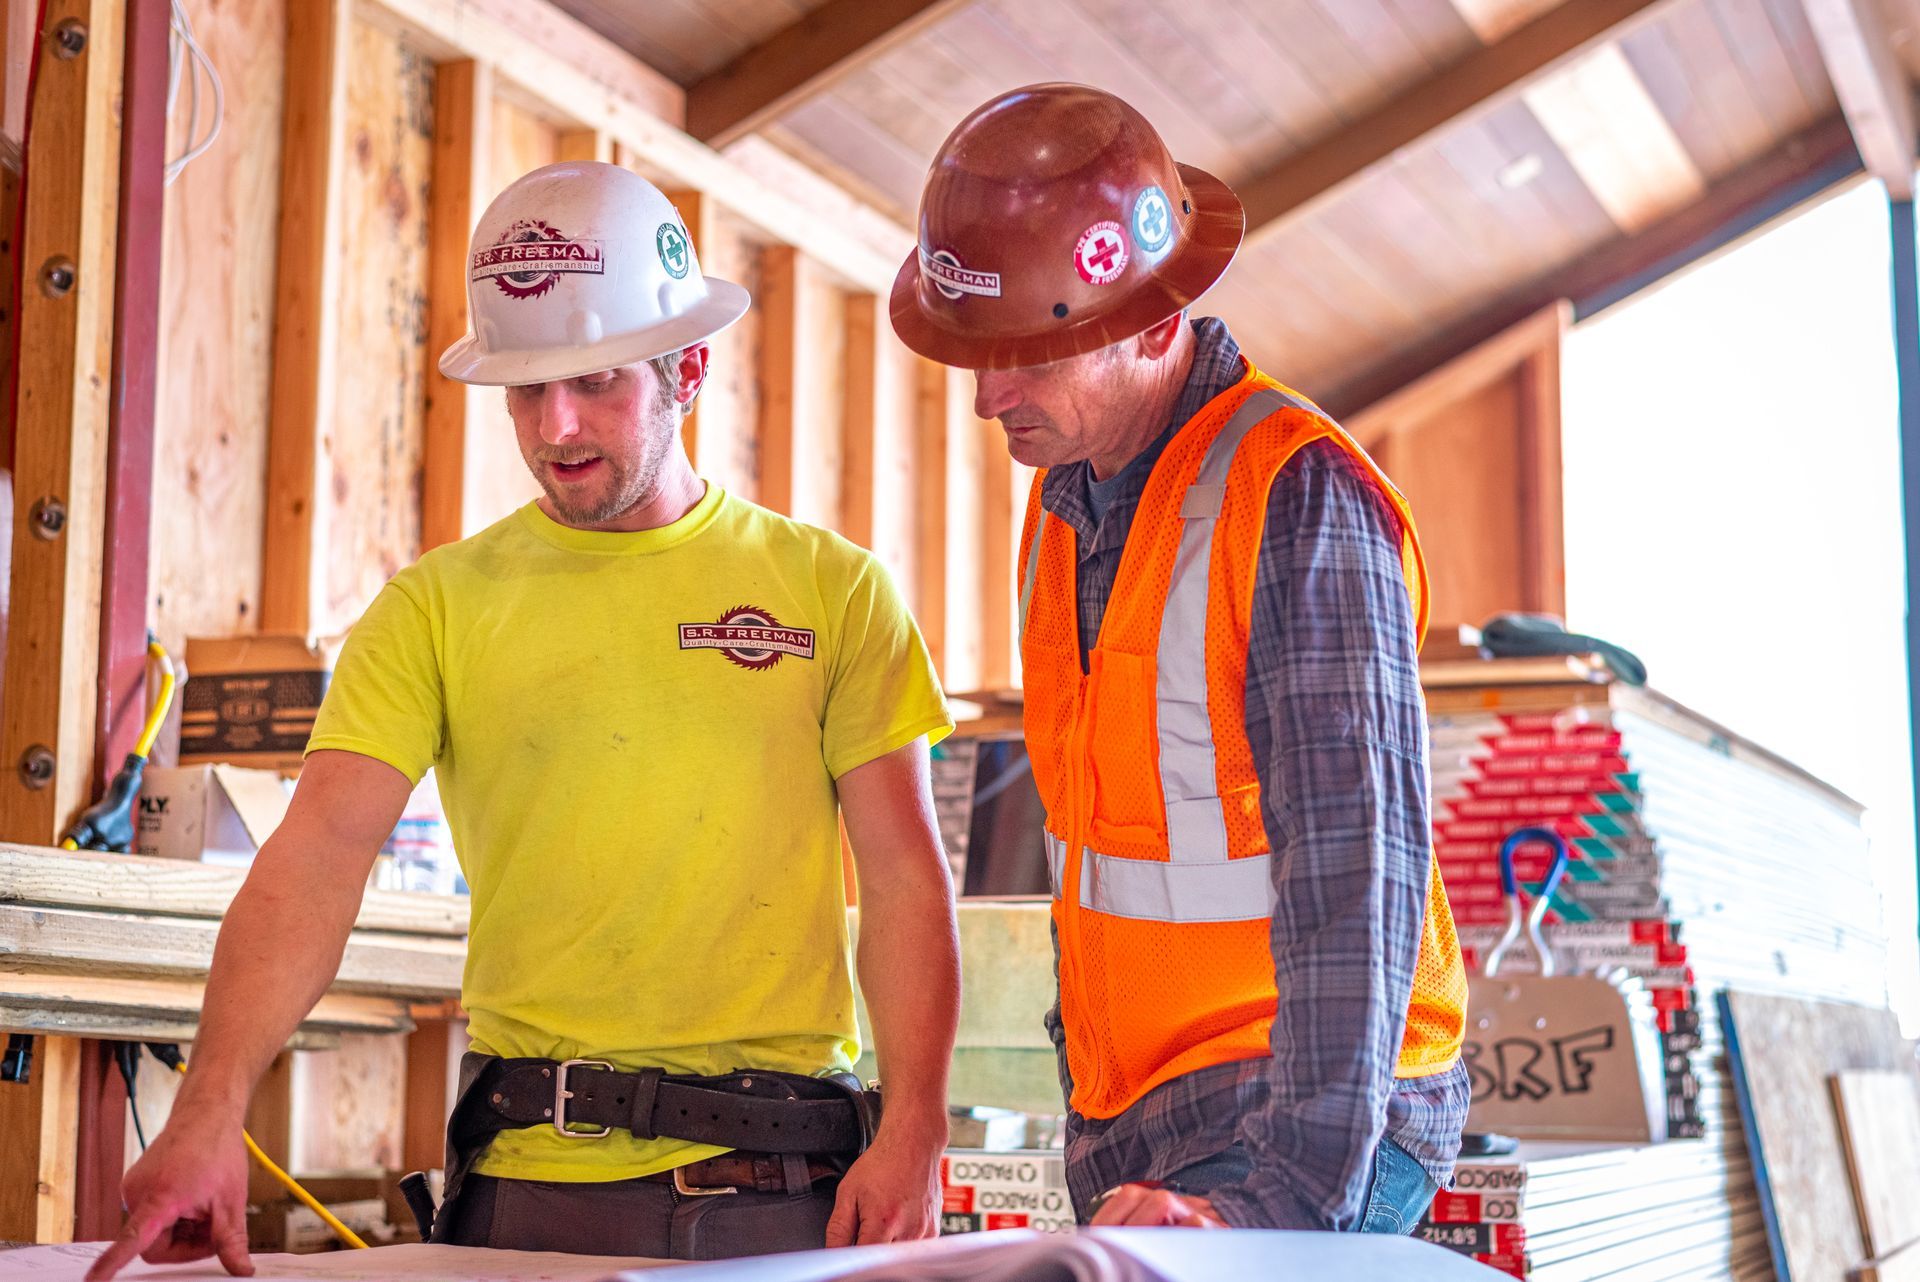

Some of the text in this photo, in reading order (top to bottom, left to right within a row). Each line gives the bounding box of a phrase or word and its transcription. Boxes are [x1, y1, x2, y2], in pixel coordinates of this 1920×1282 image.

[1085, 221, 1121, 236] CERTIFIED
[501, 245, 597, 260] FREEMAN
[930, 260, 997, 288] FREEMAN
[1101, 254, 1129, 285] FREEMAN
[686, 628, 809, 646] S.R. FREEMAN
[953, 1161, 1013, 1181] PABCO
[1456, 1168, 1527, 1189] PABCO
[979, 1191, 1038, 1210] PABCO
